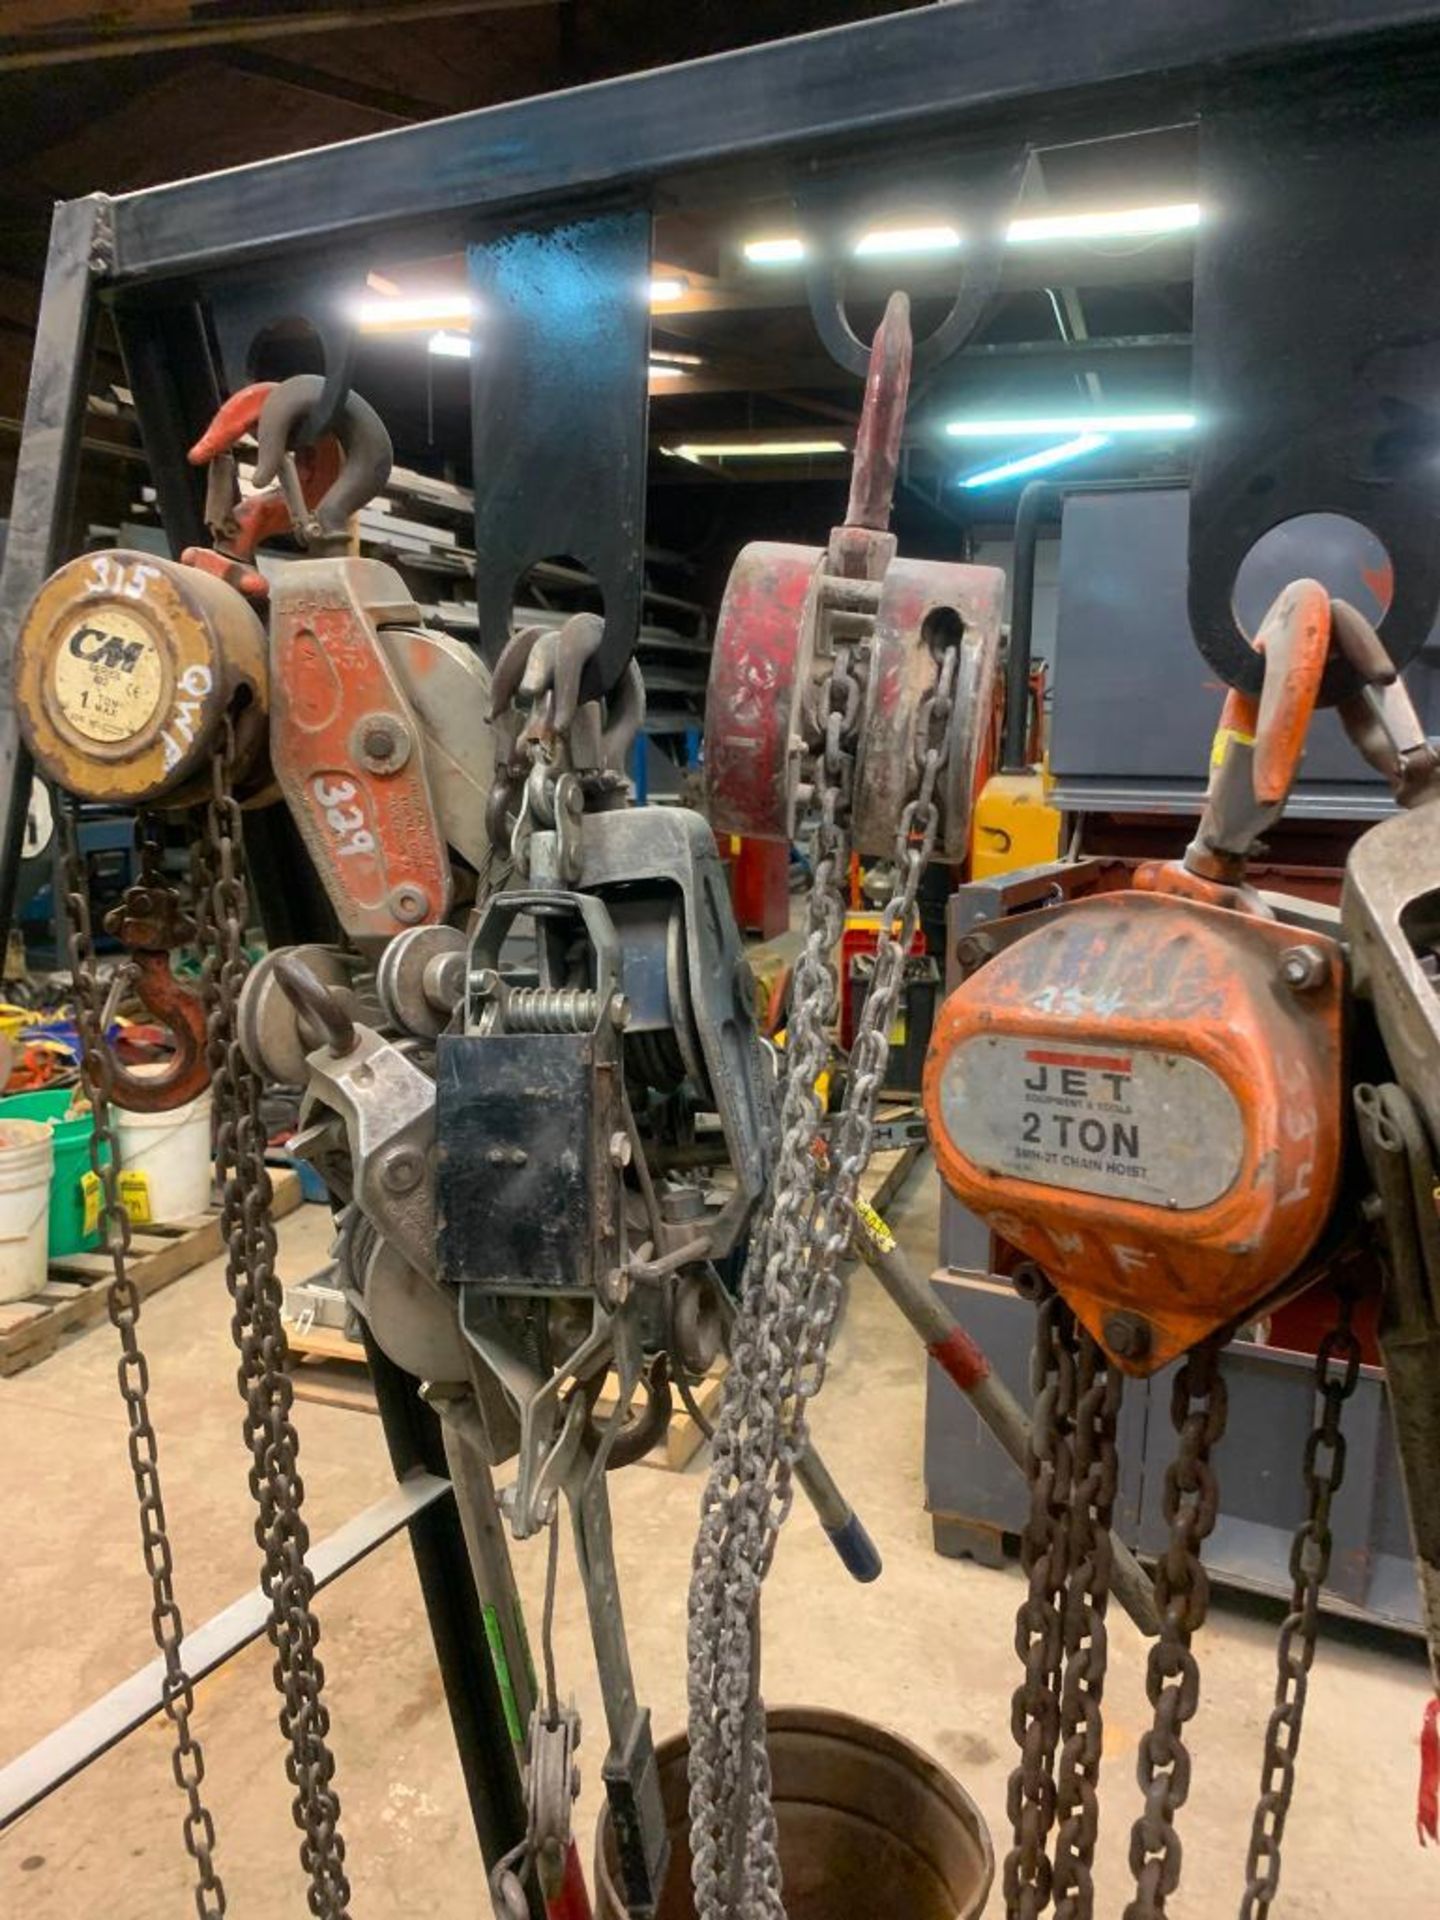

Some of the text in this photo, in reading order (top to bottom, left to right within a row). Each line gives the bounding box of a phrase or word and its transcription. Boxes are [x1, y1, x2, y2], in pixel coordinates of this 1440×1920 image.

[84, 557, 162, 599] 315
[69, 627, 145, 674] CM
[1024, 1066, 1132, 1101] JET
[1022, 1112, 1139, 1158] 2 TON
[1062, 1154, 1102, 1171] CHAIN
[1106, 1162, 1148, 1178] HOIST
